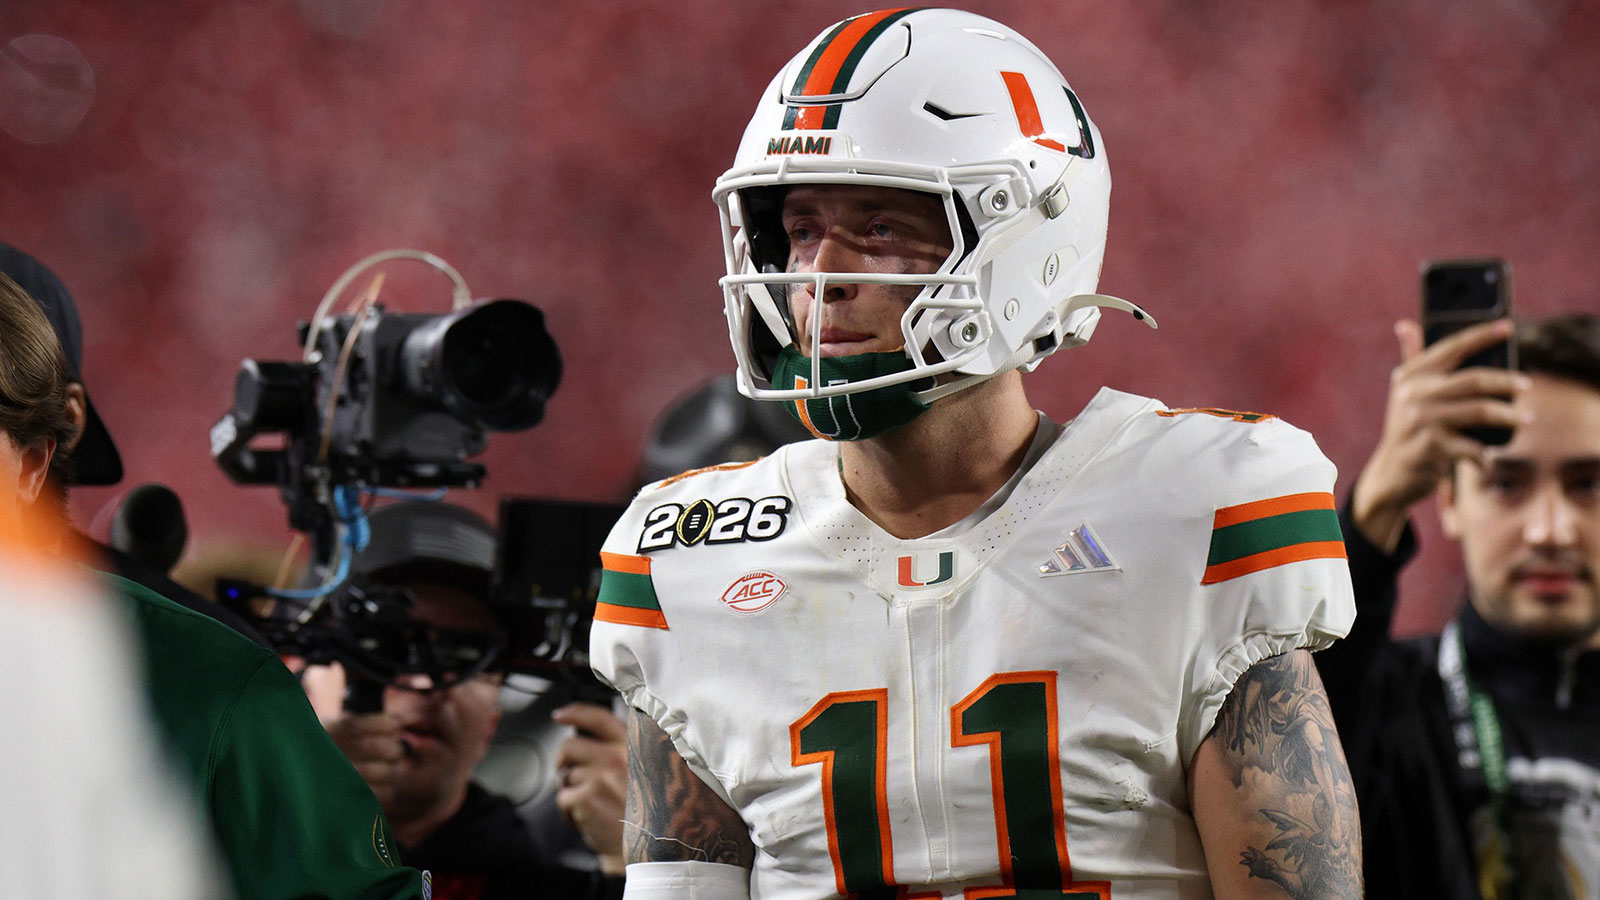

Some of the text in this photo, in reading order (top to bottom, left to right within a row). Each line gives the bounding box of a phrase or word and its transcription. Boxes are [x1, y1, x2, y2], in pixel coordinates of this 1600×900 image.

[1000, 71, 1095, 159] U
[766, 135, 832, 156] MIAMI
[636, 495, 793, 554] 2026
[731, 578, 776, 600] ACC
[898, 551, 953, 587] U
[789, 670, 1112, 900] 11
